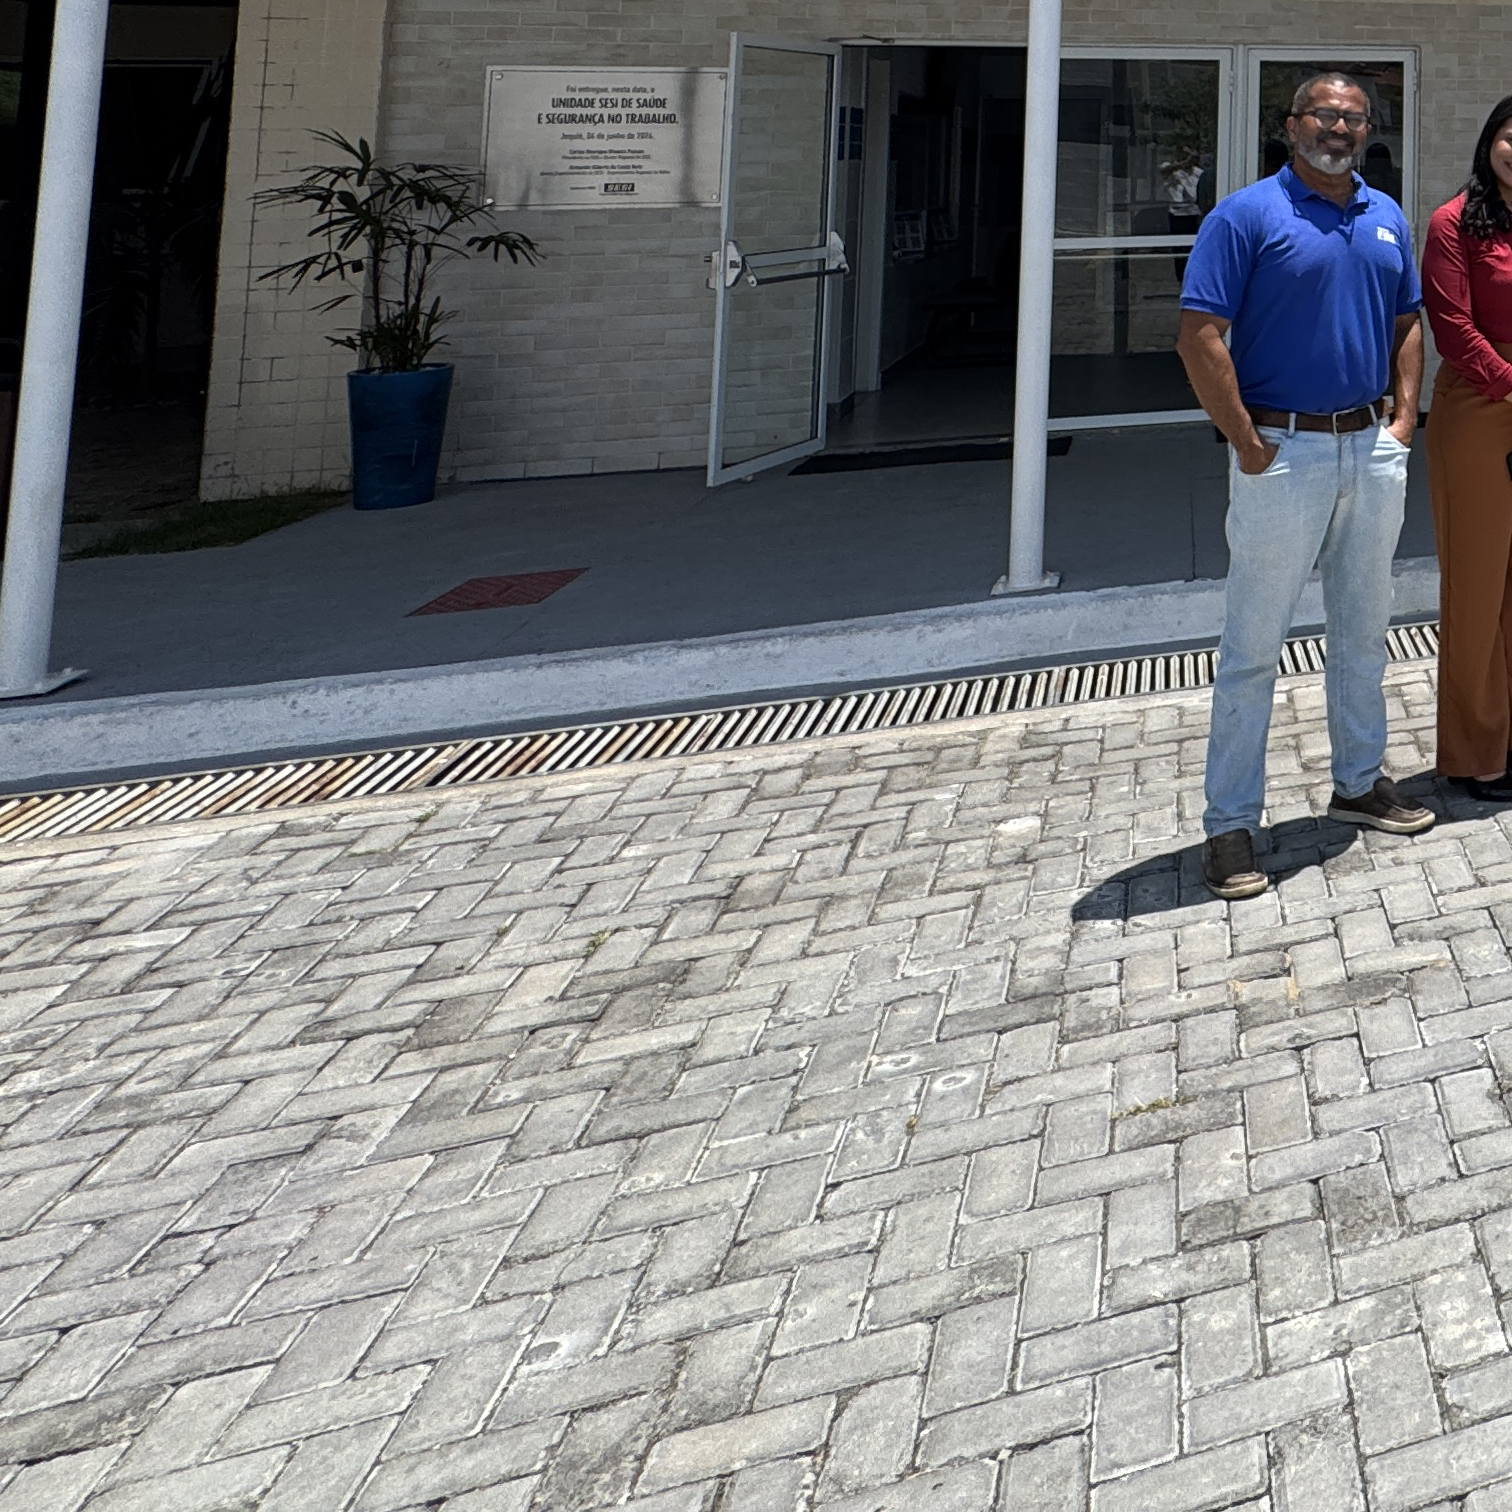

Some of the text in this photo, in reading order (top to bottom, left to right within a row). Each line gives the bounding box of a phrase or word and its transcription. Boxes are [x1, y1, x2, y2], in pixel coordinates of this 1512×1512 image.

[551, 95, 668, 109] UNIDADE SESI DE SAÚDE
[537, 112, 543, 124] E
[545, 113, 605, 126] SEGURANÇA
[607, 113, 622, 124] NO
